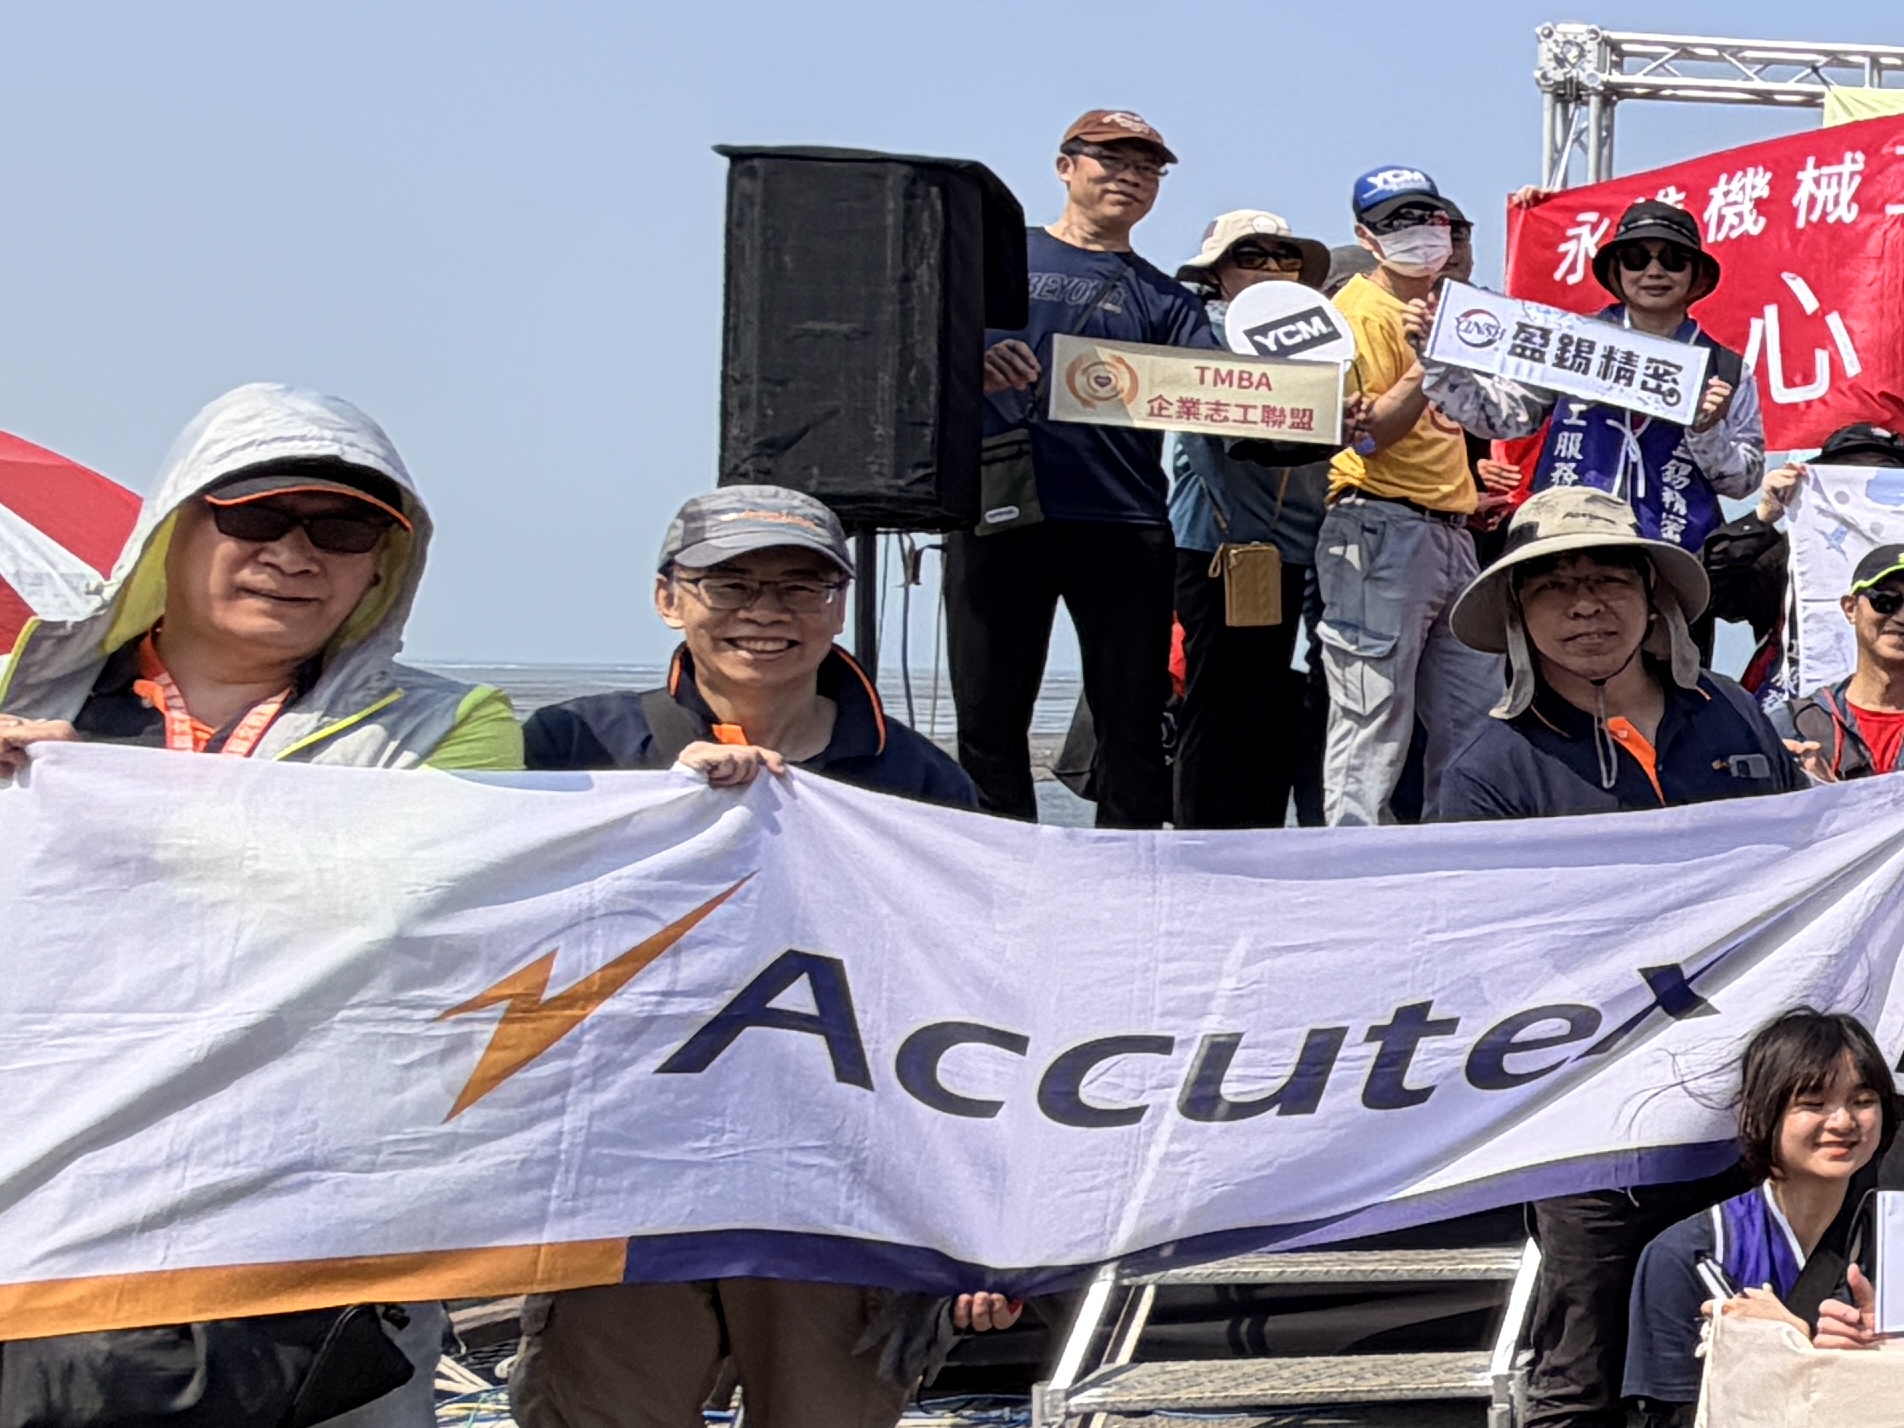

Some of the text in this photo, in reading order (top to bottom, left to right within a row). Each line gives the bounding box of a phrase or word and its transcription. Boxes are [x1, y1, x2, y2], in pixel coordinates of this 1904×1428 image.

[1194, 366, 1272, 391] TMBA
[1147, 394, 1314, 431] 企業志工聯盟
